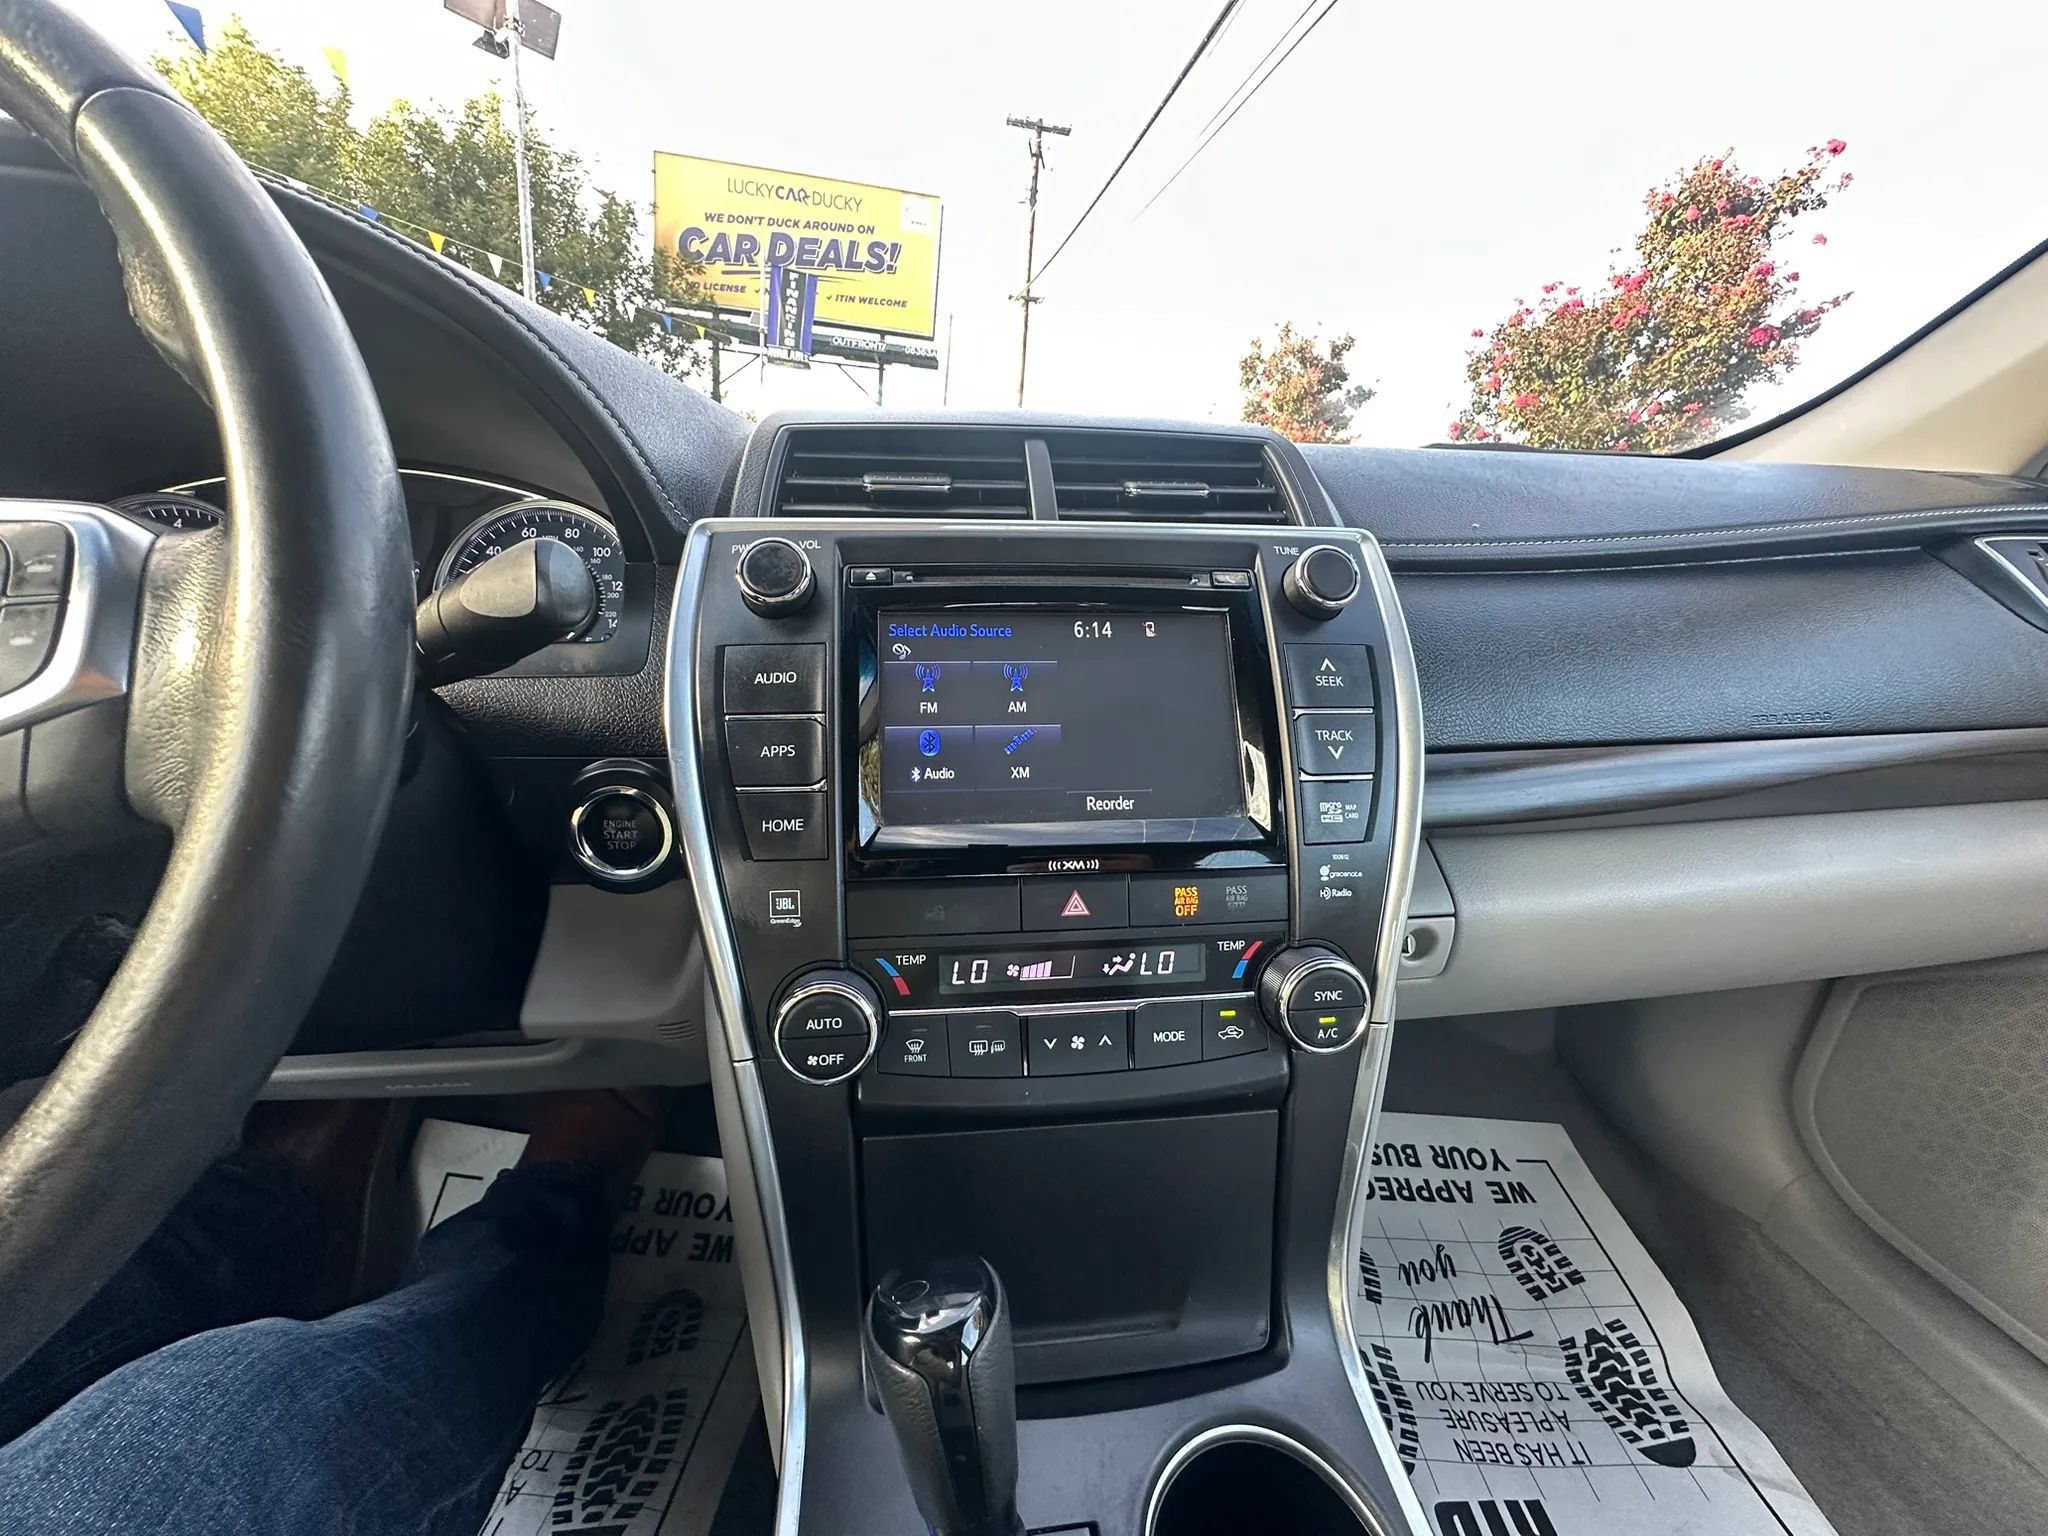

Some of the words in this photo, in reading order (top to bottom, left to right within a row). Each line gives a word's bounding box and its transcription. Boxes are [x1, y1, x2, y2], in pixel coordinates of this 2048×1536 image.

[704, 212, 725, 223] WE
[727, 214, 765, 226] DON'T
[767, 217, 801, 229] DUCK
[803, 220, 854, 233] AROUND
[857, 225, 875, 235] ON
[678, 226, 761, 267] CAR
[767, 231, 902, 275] DEALS!
[703, 283, 747, 293] LICENSE
[835, 294, 856, 304] ITIN
[858, 295, 909, 308] WELCOME
[173, 519, 183, 529] 4
[521, 528, 537, 538] 60
[564, 528, 580, 538] 80
[486, 546, 501, 556] 40
[593, 547, 611, 557] 100
[731, 544, 750, 554] PW
[799, 540, 821, 550] VOL
[1273, 546, 1300, 556] TUNE
[611, 581, 623, 592] 12
[608, 619, 618, 629] 14
[889, 623, 927, 638] Select
[930, 623, 967, 638] Audio
[970, 623, 1012, 638] Source
[1073, 620, 1112, 640] 6:14
[754, 671, 797, 685] AUDIO
[1315, 675, 1344, 687] SEEK
[919, 701, 938, 715] FM
[1007, 700, 1027, 714] AM
[1315, 730, 1353, 741] TRACK
[760, 744, 796, 758] APPS
[924, 766, 955, 780] Audio
[1010, 767, 1030, 780] XM
[1086, 795, 1135, 811] Reorder
[603, 819, 637, 829] ENGINE
[762, 818, 804, 832] HOME
[603, 830, 638, 840] START
[607, 841, 637, 850] STOP
[1174, 886, 1198, 897] PASS
[1226, 885, 1247, 895] PASS
[1332, 888, 1352, 897] Radio
[776, 898, 795, 910] JBL
[1174, 897, 1186, 905] AIR
[1186, 896, 1198, 904] BAG
[1175, 905, 1198, 916] OFF
[1217, 940, 1246, 951] TEMP
[895, 954, 927, 966] TEMP
[1139, 951, 1175, 976] LO
[951, 959, 989, 986] LO
[1314, 990, 1343, 1002] SYNC
[806, 1017, 843, 1031] AUTO
[1153, 1030, 1186, 1043] MODE
[1317, 1027, 1339, 1039] A/C
[819, 1053, 845, 1066] OFF
[904, 1053, 928, 1063] FRONT
[1428, 1144, 1512, 1172] YOUR
[1485, 1181, 1537, 1204] WE
[654, 1188, 733, 1222] YOUR
[688, 1232, 734, 1263] WE
[1399, 1243, 1457, 1286] you
[1408, 1294, 1534, 1363] Thank
[1416, 1381, 1463, 1401] YOU
[1463, 1381, 1533, 1403] SERVE
[1535, 1381, 1570, 1402] TO
[1439, 1408, 1554, 1434] PLEASURE
[1550, 1410, 1571, 1433] A
[1453, 1438, 1514, 1466] BEEN
[1513, 1442, 1567, 1467] HAS
[1567, 1441, 1593, 1466] IT
[521, 1450, 553, 1472] TO
[505, 1480, 528, 1506] A
